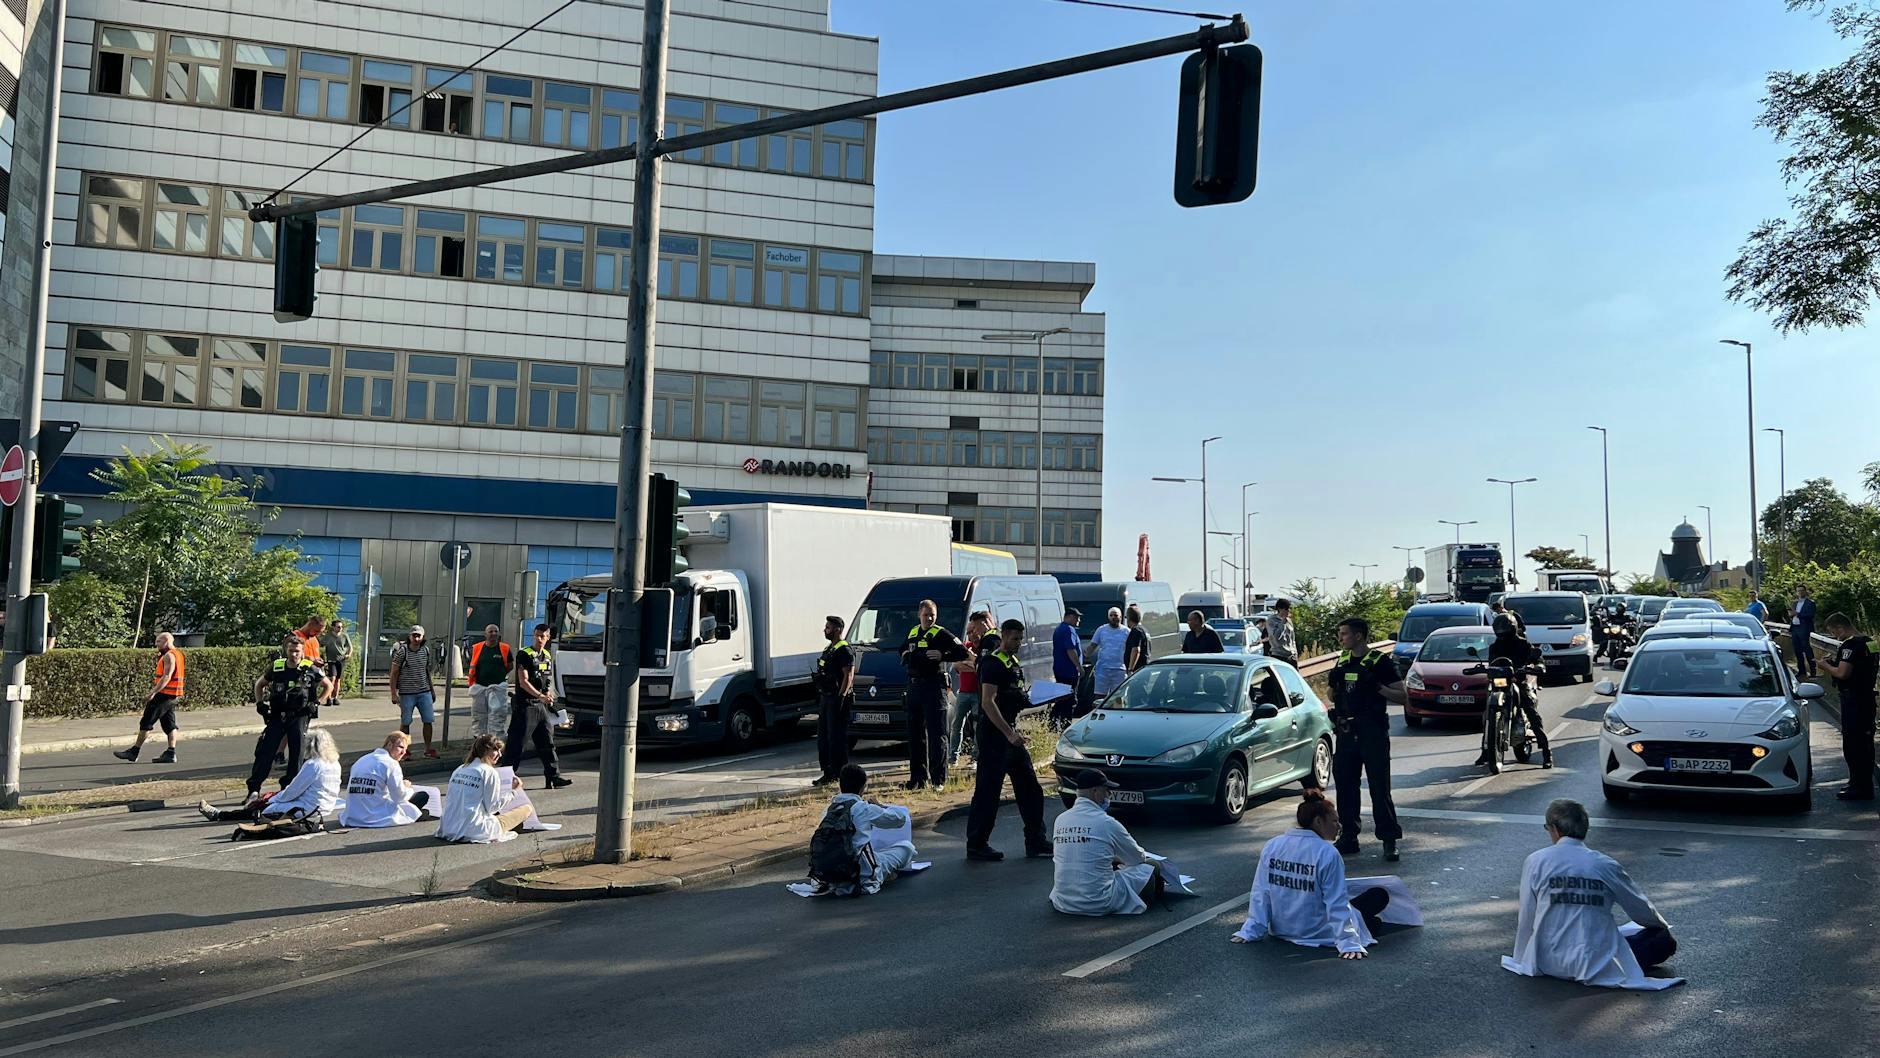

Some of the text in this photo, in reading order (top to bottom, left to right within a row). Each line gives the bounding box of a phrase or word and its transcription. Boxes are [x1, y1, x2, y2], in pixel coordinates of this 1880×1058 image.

[767, 250, 802, 263] Fachober
[761, 459, 851, 479] RANDORI
[1685, 760, 1700, 769] AP
[1702, 760, 1729, 771] 2232
[1120, 791, 1143, 803] 2798
[1269, 857, 1315, 876] SCIENTIST
[1268, 872, 1315, 893] REBELLION
[1550, 876, 1604, 891] SCIENTIST
[1550, 892, 1605, 906] REBELLION
